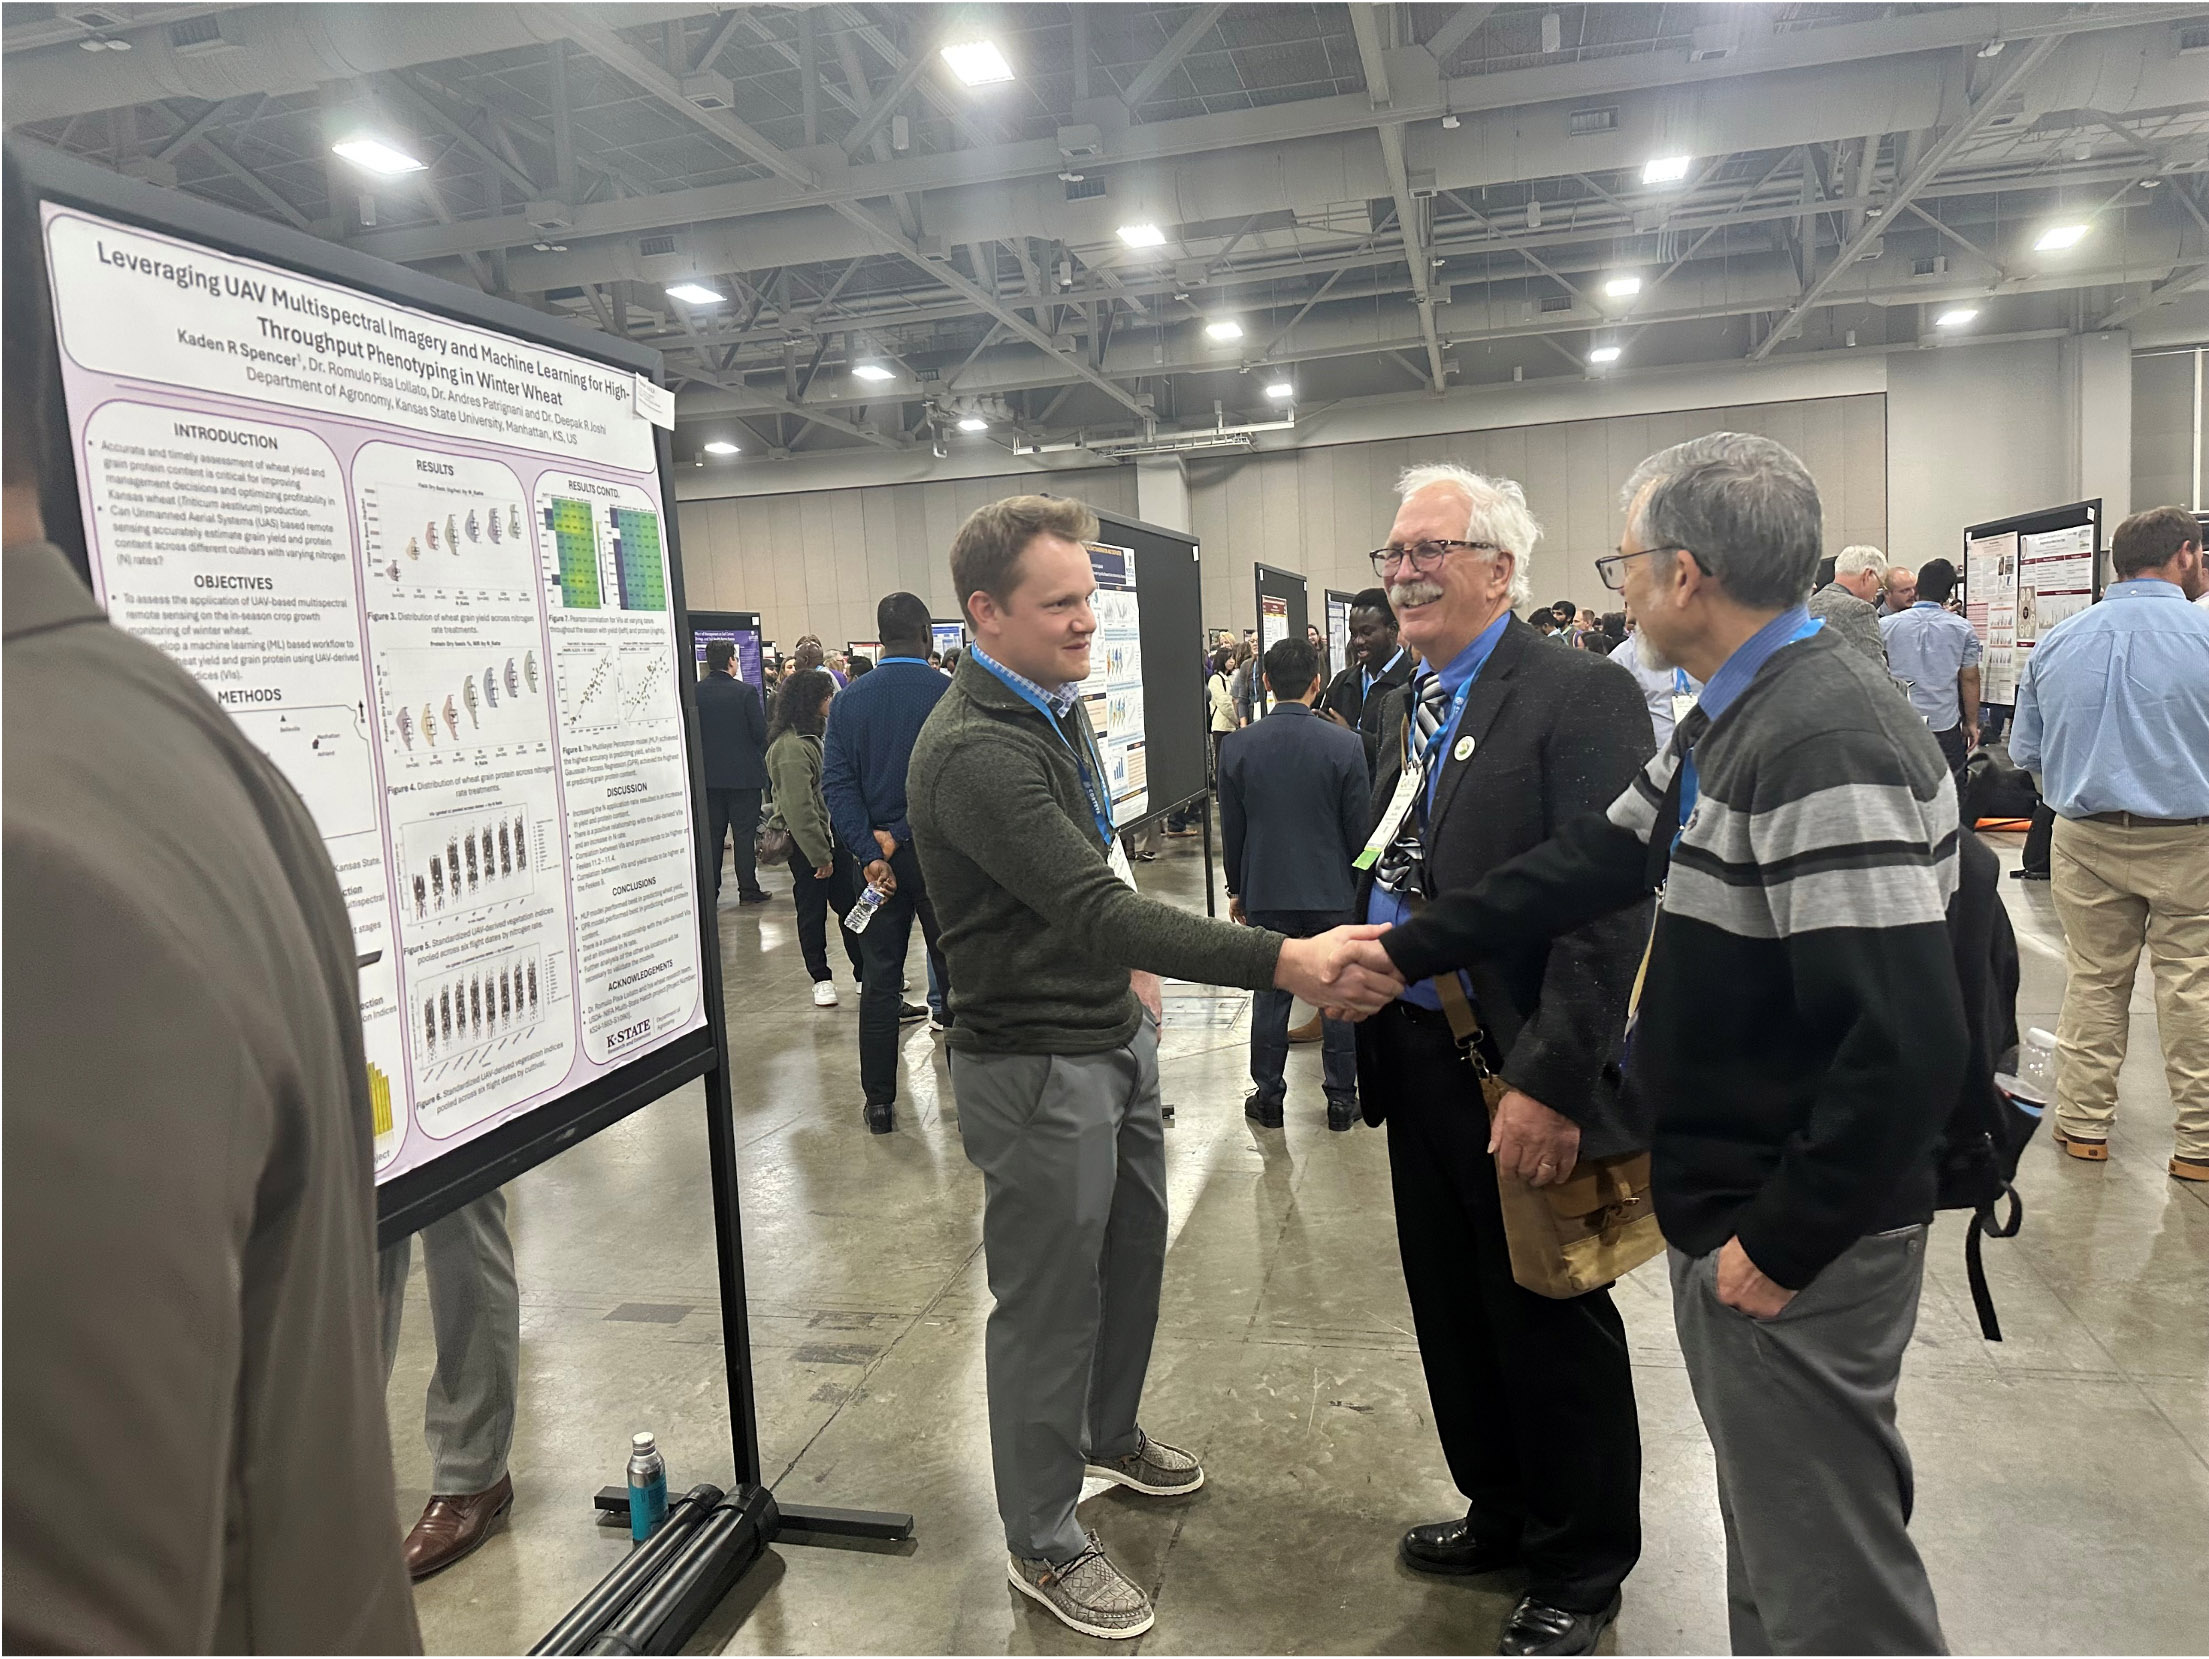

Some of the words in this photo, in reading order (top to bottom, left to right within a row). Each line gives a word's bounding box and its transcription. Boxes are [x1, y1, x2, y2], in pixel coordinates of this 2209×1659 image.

[97, 241, 220, 297] Leveraging
[225, 275, 265, 303] UAV
[272, 287, 386, 336] Multispectral
[390, 320, 446, 355] Imagery
[451, 342, 477, 359] and
[482, 345, 533, 374] Machine
[537, 361, 587, 391] Learning
[588, 375, 602, 392] for
[605, 380, 629, 400] High-
[257, 316, 364, 358] Throughput
[367, 343, 457, 386] Phenotyping
[460, 367, 473, 385] in
[476, 371, 519, 396] Winter
[520, 382, 562, 406] Wheat
[177, 329, 224, 352] Kaden
[227, 340, 236, 355] R
[308, 357, 325, 373] Dr.
[329, 362, 370, 383] Romulo
[373, 372, 393, 388] Pisa
[395, 377, 429, 399] Lollato,
[431, 386, 445, 400] Dr.
[448, 390, 480, 407] Andres
[482, 397, 522, 416] Patrignani
[524, 409, 539, 420] and
[542, 410, 553, 423] Dr.
[554, 413, 582, 430] Deepak
[584, 420, 589, 430] R
[590, 422, 606, 435] Joshi
[246, 366, 321, 394] Department
[324, 384, 336, 396] of
[339, 385, 393, 410] Agronomy,
[395, 397, 428, 416] Kansas
[430, 405, 456, 421] State
[458, 411, 504, 432] University,
[506, 420, 551, 441] Manhattan,
[553, 430, 565, 443] KS,
[566, 433, 577, 445] US
[174, 423, 278, 450] INTRODUCTION
[416, 460, 454, 476] RESULTS
[568, 480, 595, 494] RESULTS
[596, 486, 620, 498] CONTD.
[194, 575, 272, 590] OBJECTIVES
[158, 641, 179, 652] elop
[176, 657, 196, 666] heat
[194, 672, 218, 681] dices
[218, 689, 281, 704] METHODS
[607, 783, 647, 797] DISCUSSION
[1089, 789, 1100, 814] CORTEVA
[342, 886, 363, 896] ction
[612, 877, 656, 896] CONCLUSIONS
[608, 959, 672, 991] ACKNOWLEDGEMENTS
[360, 997, 384, 1010] ection
[375, 1150, 390, 1164] ject
